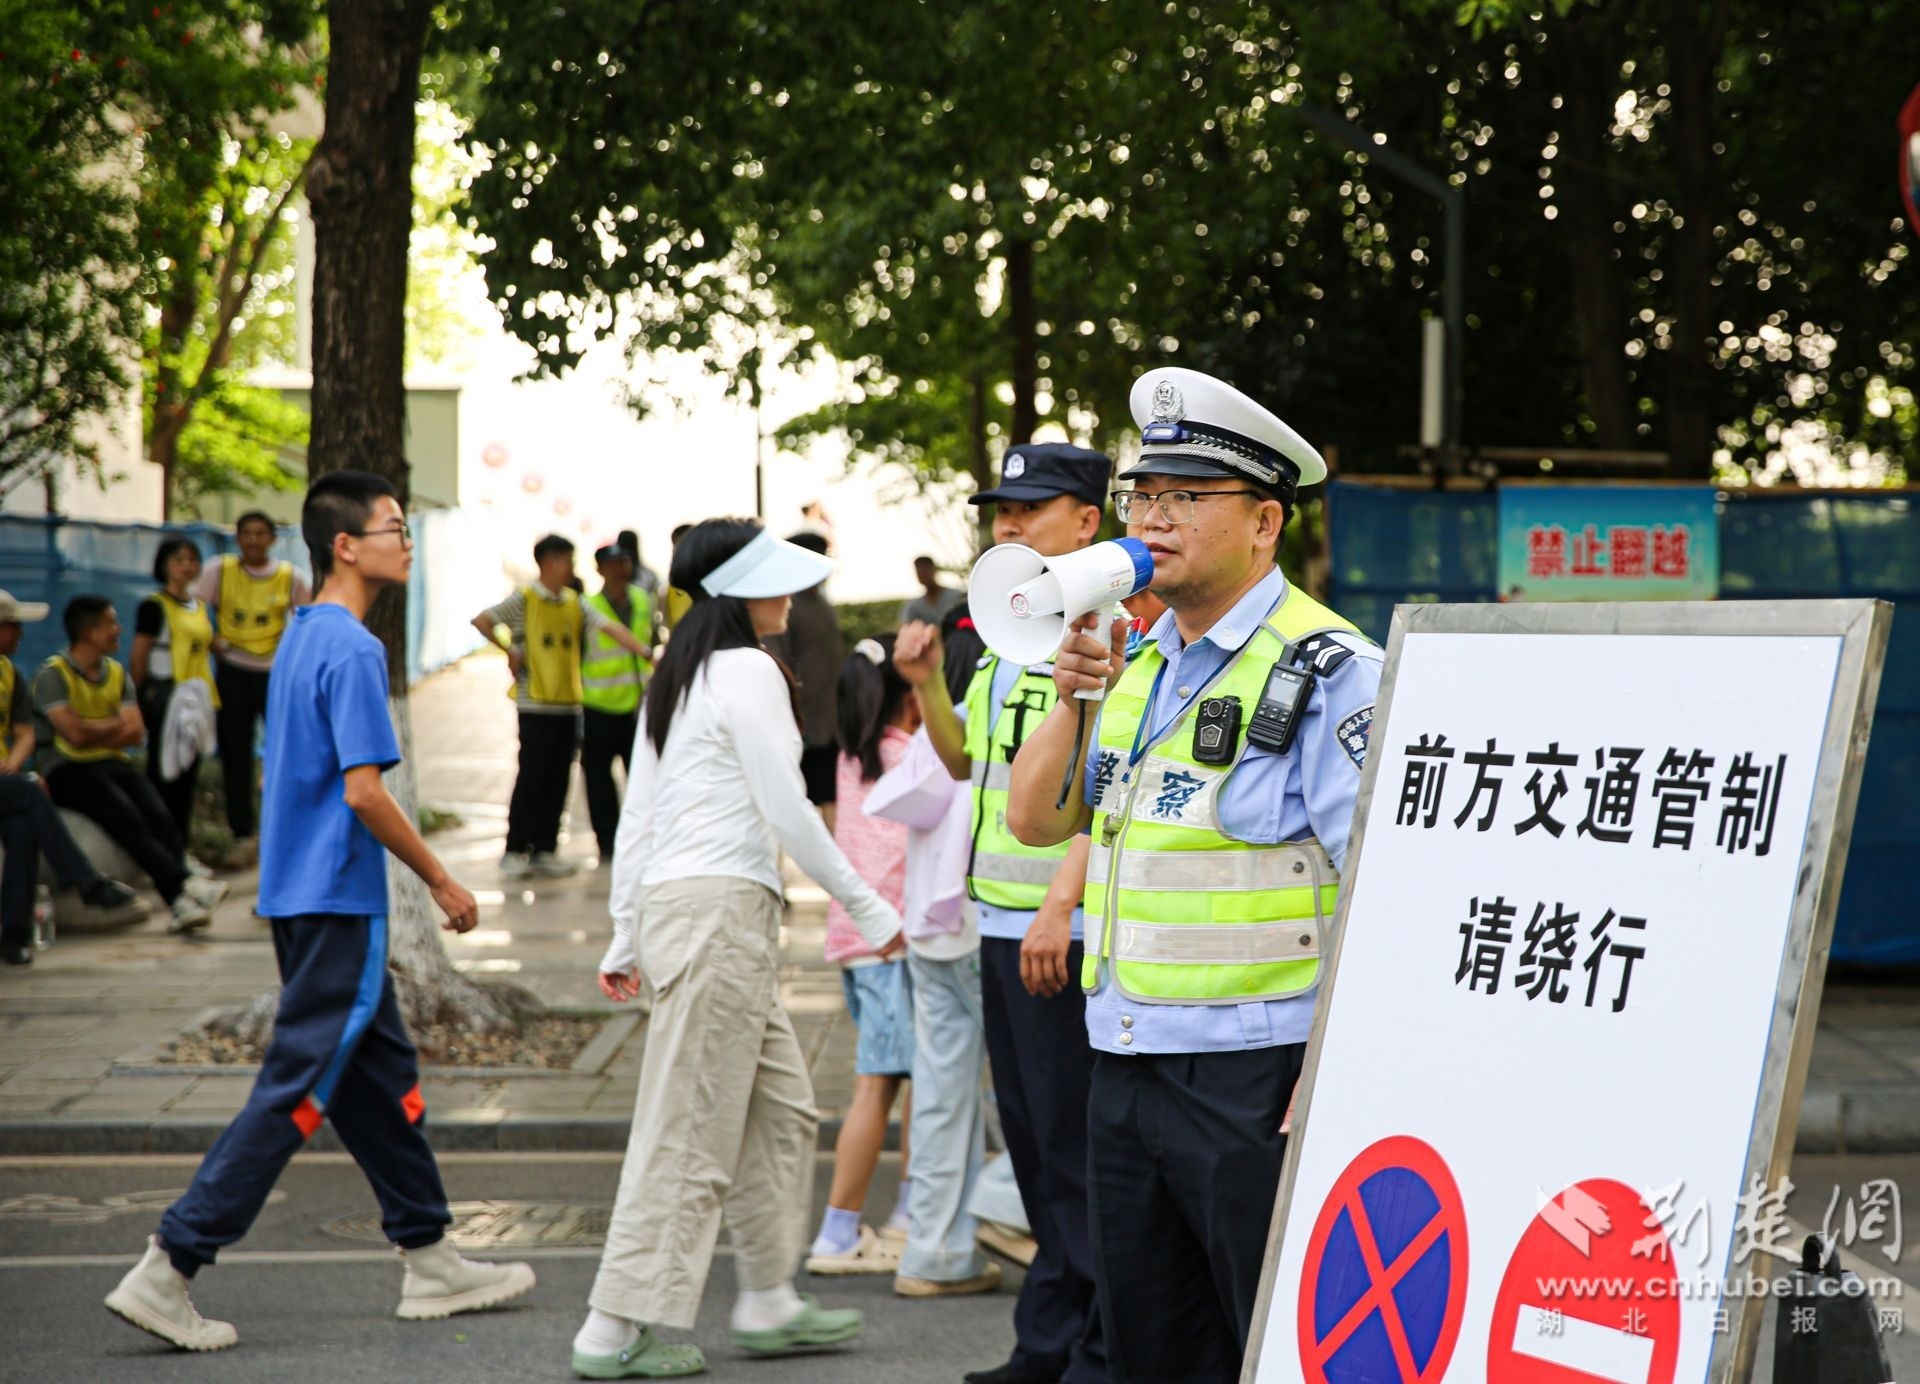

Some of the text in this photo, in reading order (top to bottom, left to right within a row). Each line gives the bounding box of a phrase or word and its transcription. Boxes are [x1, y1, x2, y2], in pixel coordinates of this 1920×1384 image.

[1527, 525, 1690, 579] 禁止翻越
[1395, 732, 1789, 857] 前方交通管制
[1455, 896, 1648, 1013] 请绕行
